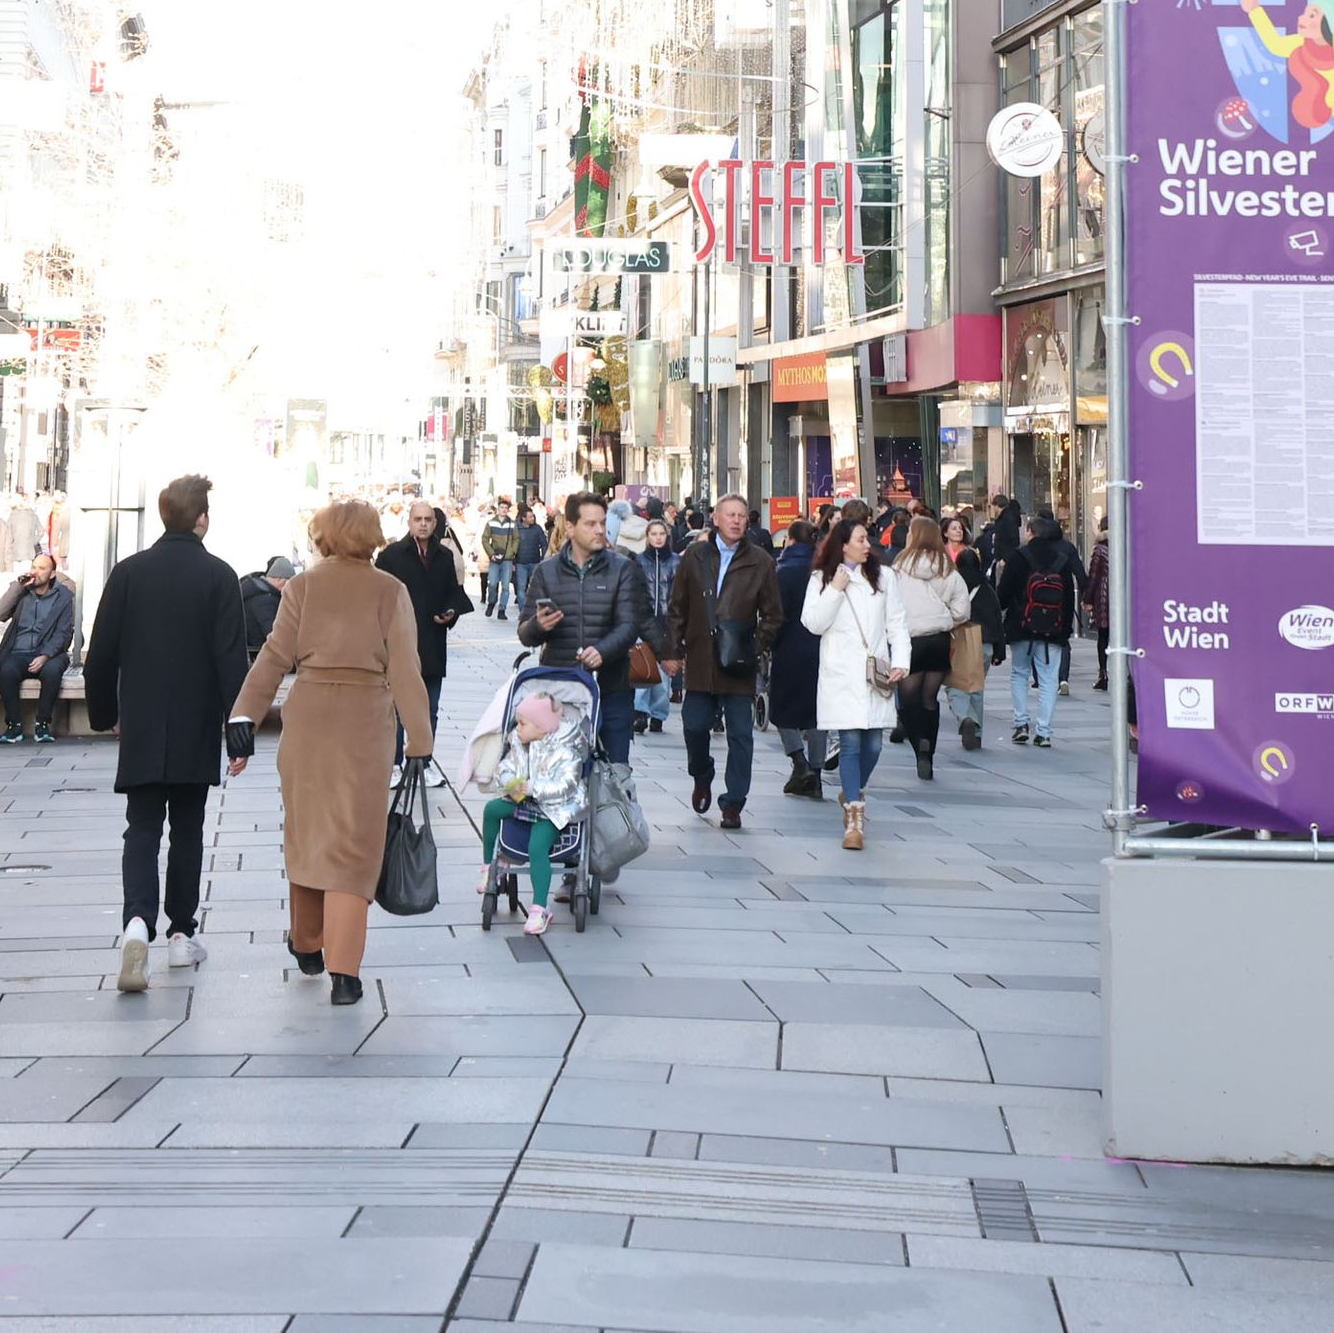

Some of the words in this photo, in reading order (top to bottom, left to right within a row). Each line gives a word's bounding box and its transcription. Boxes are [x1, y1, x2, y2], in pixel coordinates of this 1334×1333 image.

[1157, 138, 1317, 176] Wiener
[690, 159, 866, 265] STEFFL
[1163, 600, 1229, 623] Stadt
[1289, 613, 1334, 627] Wien
[1163, 626, 1229, 649] Wien
